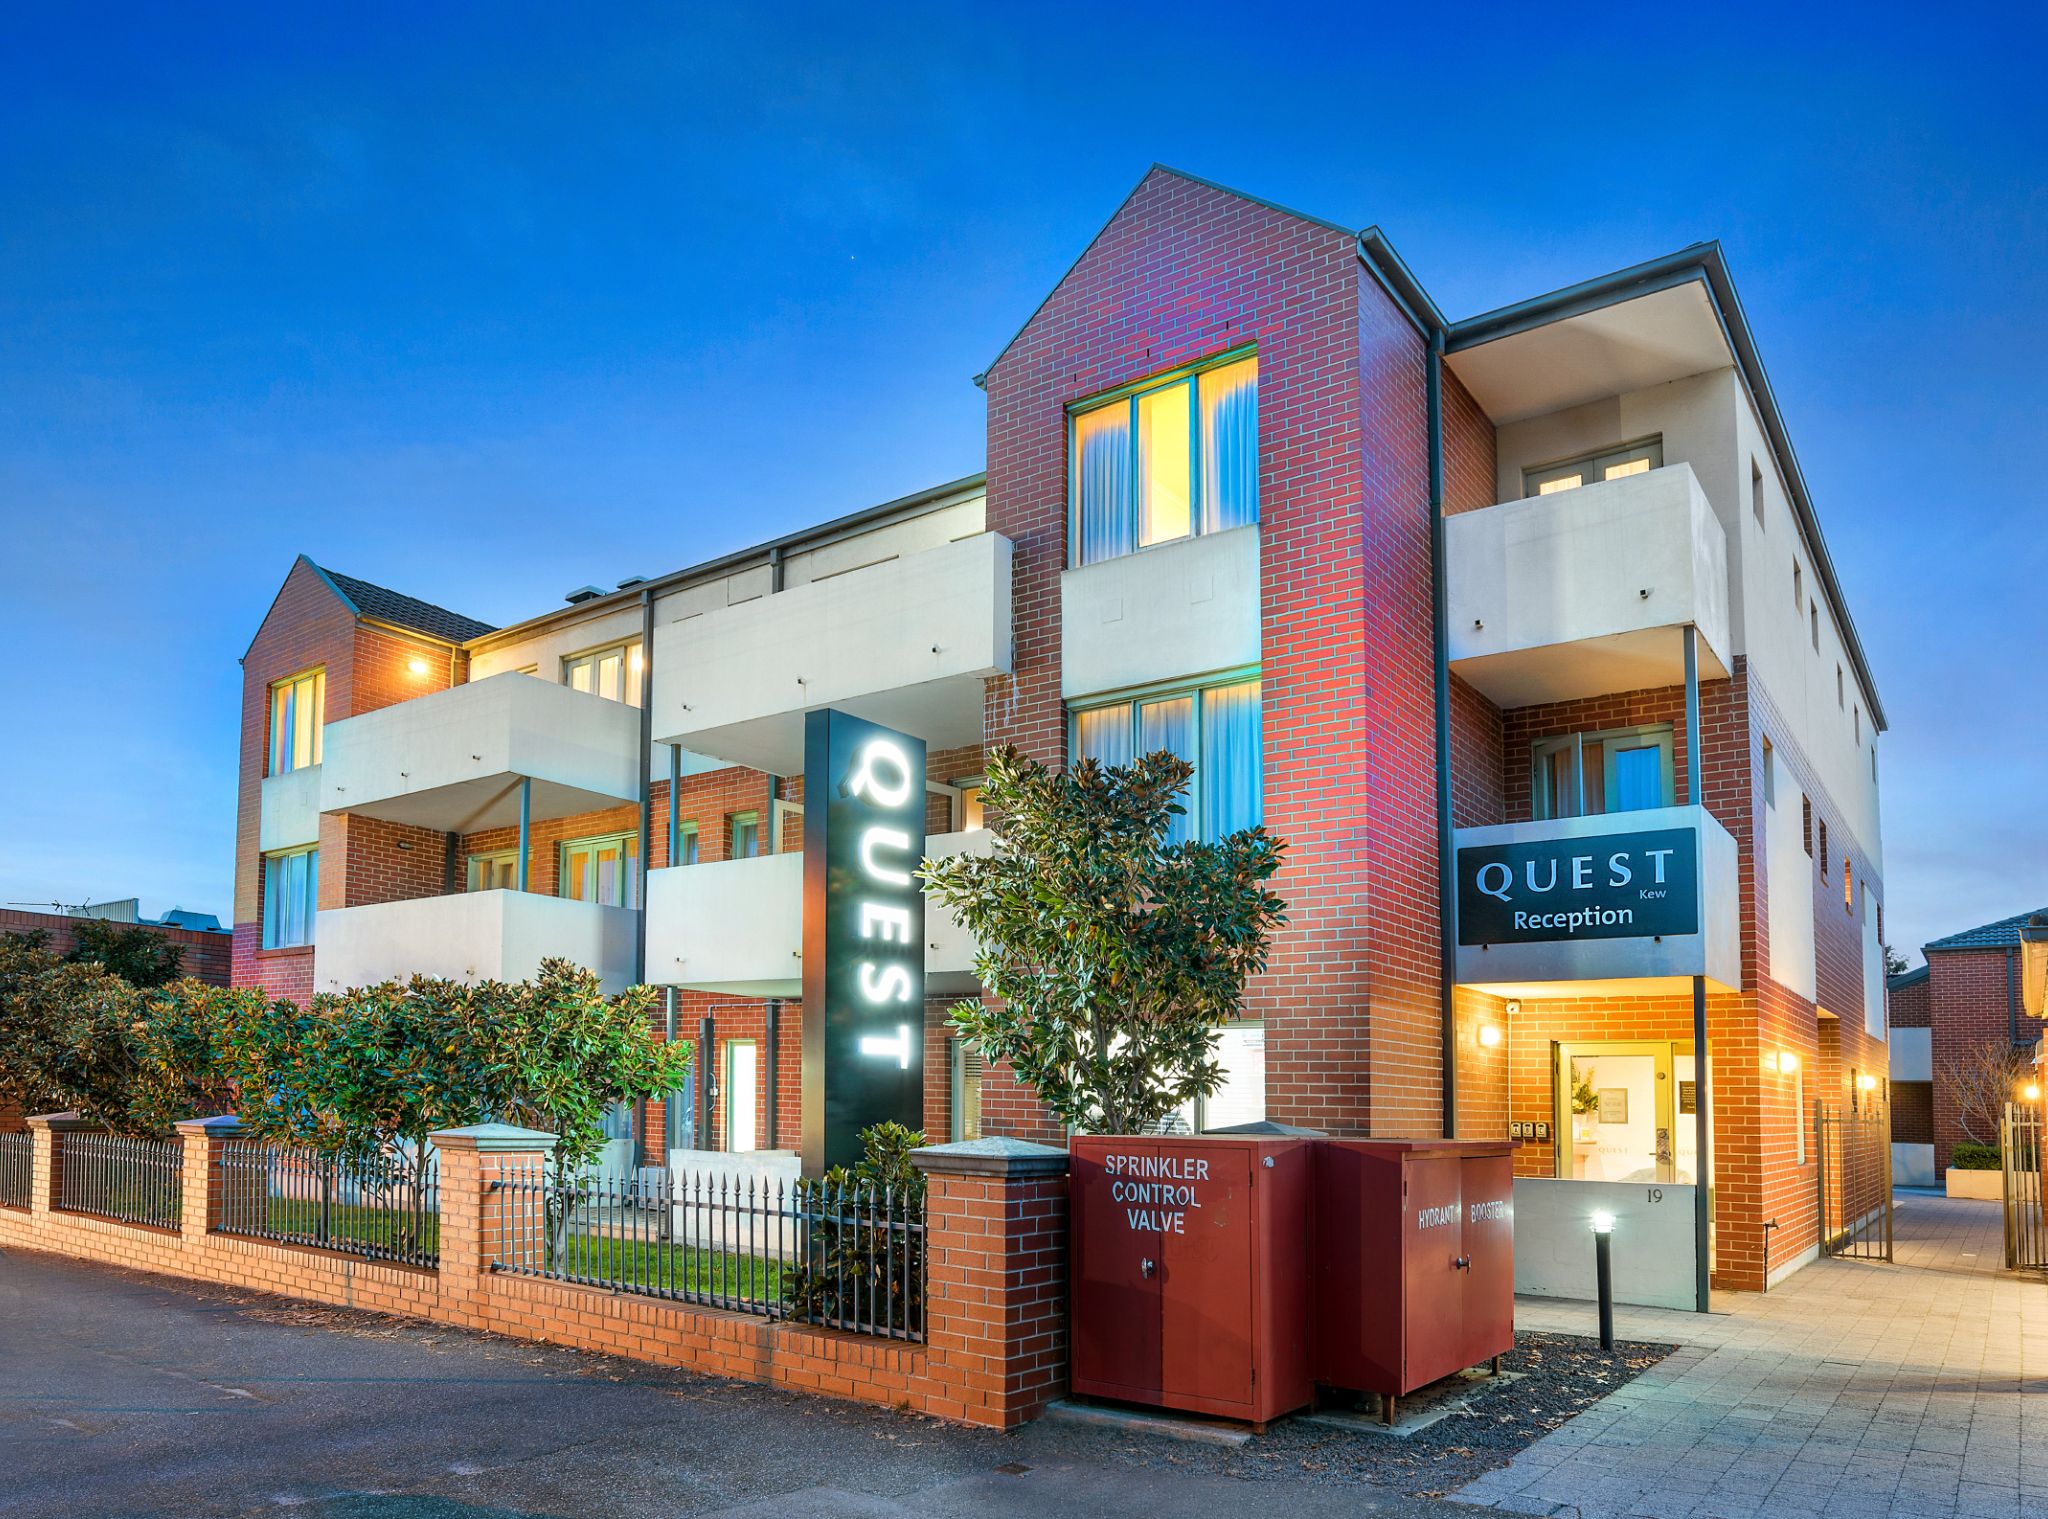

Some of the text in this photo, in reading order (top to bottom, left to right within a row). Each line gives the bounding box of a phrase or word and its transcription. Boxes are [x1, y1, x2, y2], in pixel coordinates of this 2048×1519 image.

[1475, 848, 1674, 902] QUEST
[852, 739, 912, 1070] QUEST
[1639, 888, 1667, 900] Kew
[1514, 905, 1633, 933] Reception
[1105, 1154, 1209, 1181] SPRINKLER
[1112, 1181, 1202, 1208] CONTROL
[1647, 1188, 1663, 1203] 19
[1127, 1208, 1185, 1234] VALVE
[1418, 1200, 1505, 1230] HYDRANT BOOSTER
